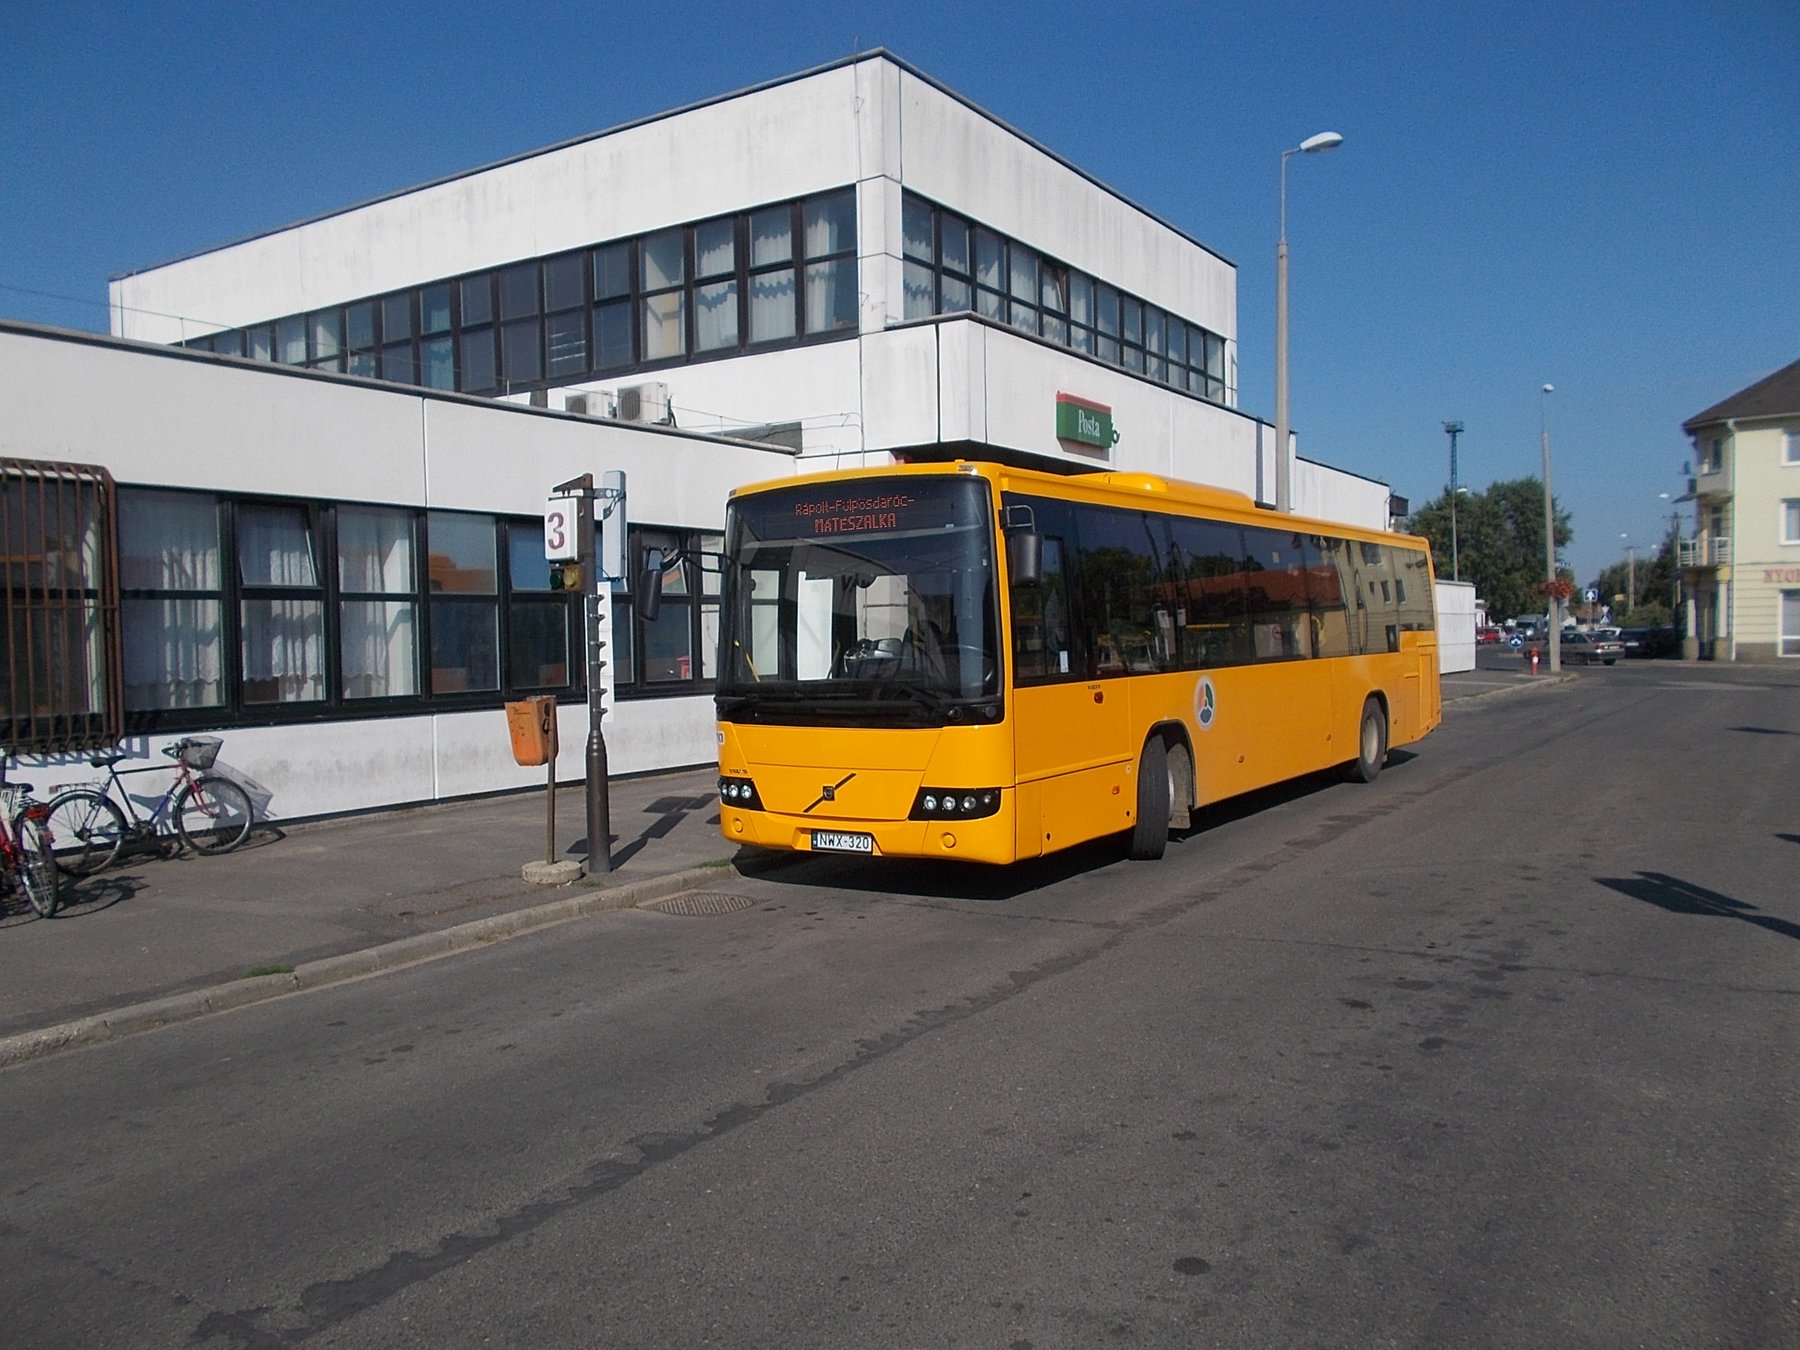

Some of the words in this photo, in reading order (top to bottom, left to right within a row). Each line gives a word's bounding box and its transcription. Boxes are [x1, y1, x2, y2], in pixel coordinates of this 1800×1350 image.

[1078, 409, 1101, 437] Posta
[547, 511, 565, 550] 3
[819, 833, 869, 850] NWX-320
